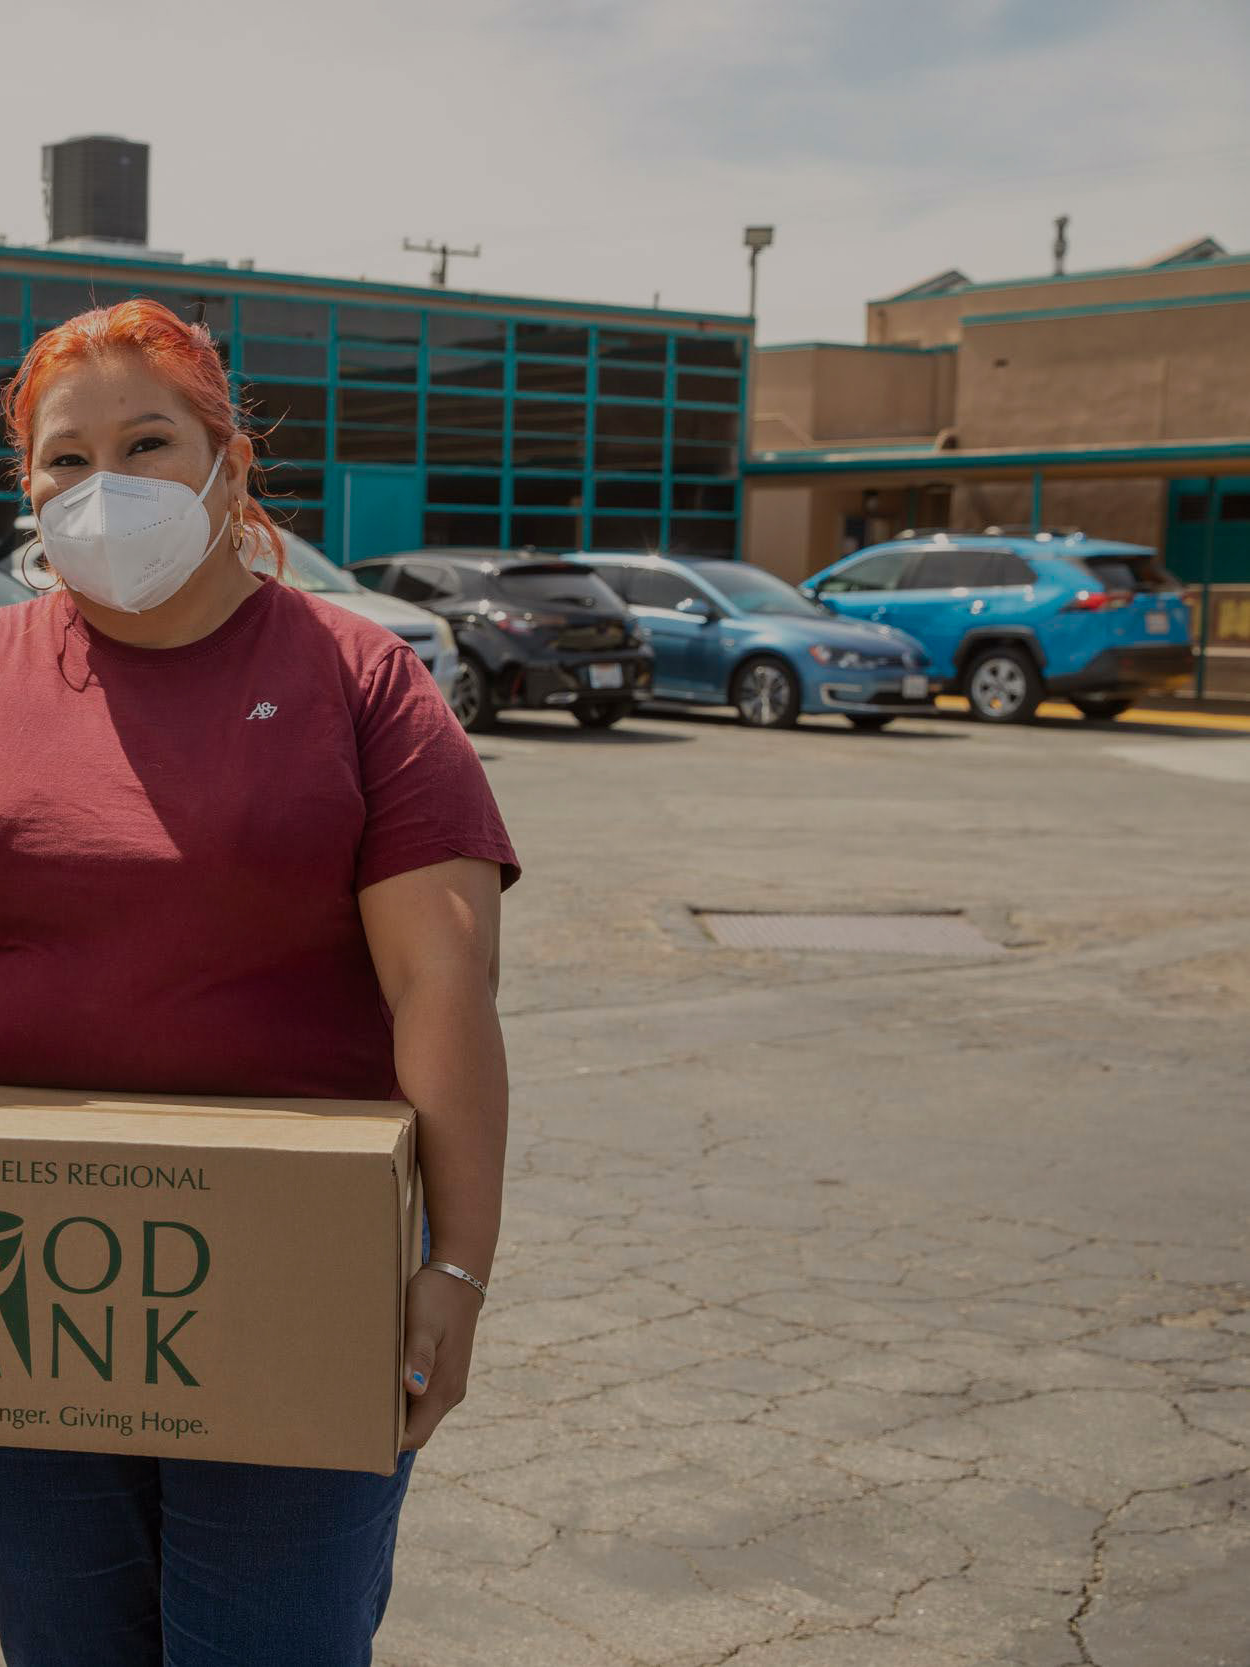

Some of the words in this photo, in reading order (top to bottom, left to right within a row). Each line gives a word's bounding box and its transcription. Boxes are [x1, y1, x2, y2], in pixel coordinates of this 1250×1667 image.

[67, 1162, 211, 1191] REGIONAL
[58, 1406, 134, 1437] Giving
[141, 1410, 209, 1440] Hope.
